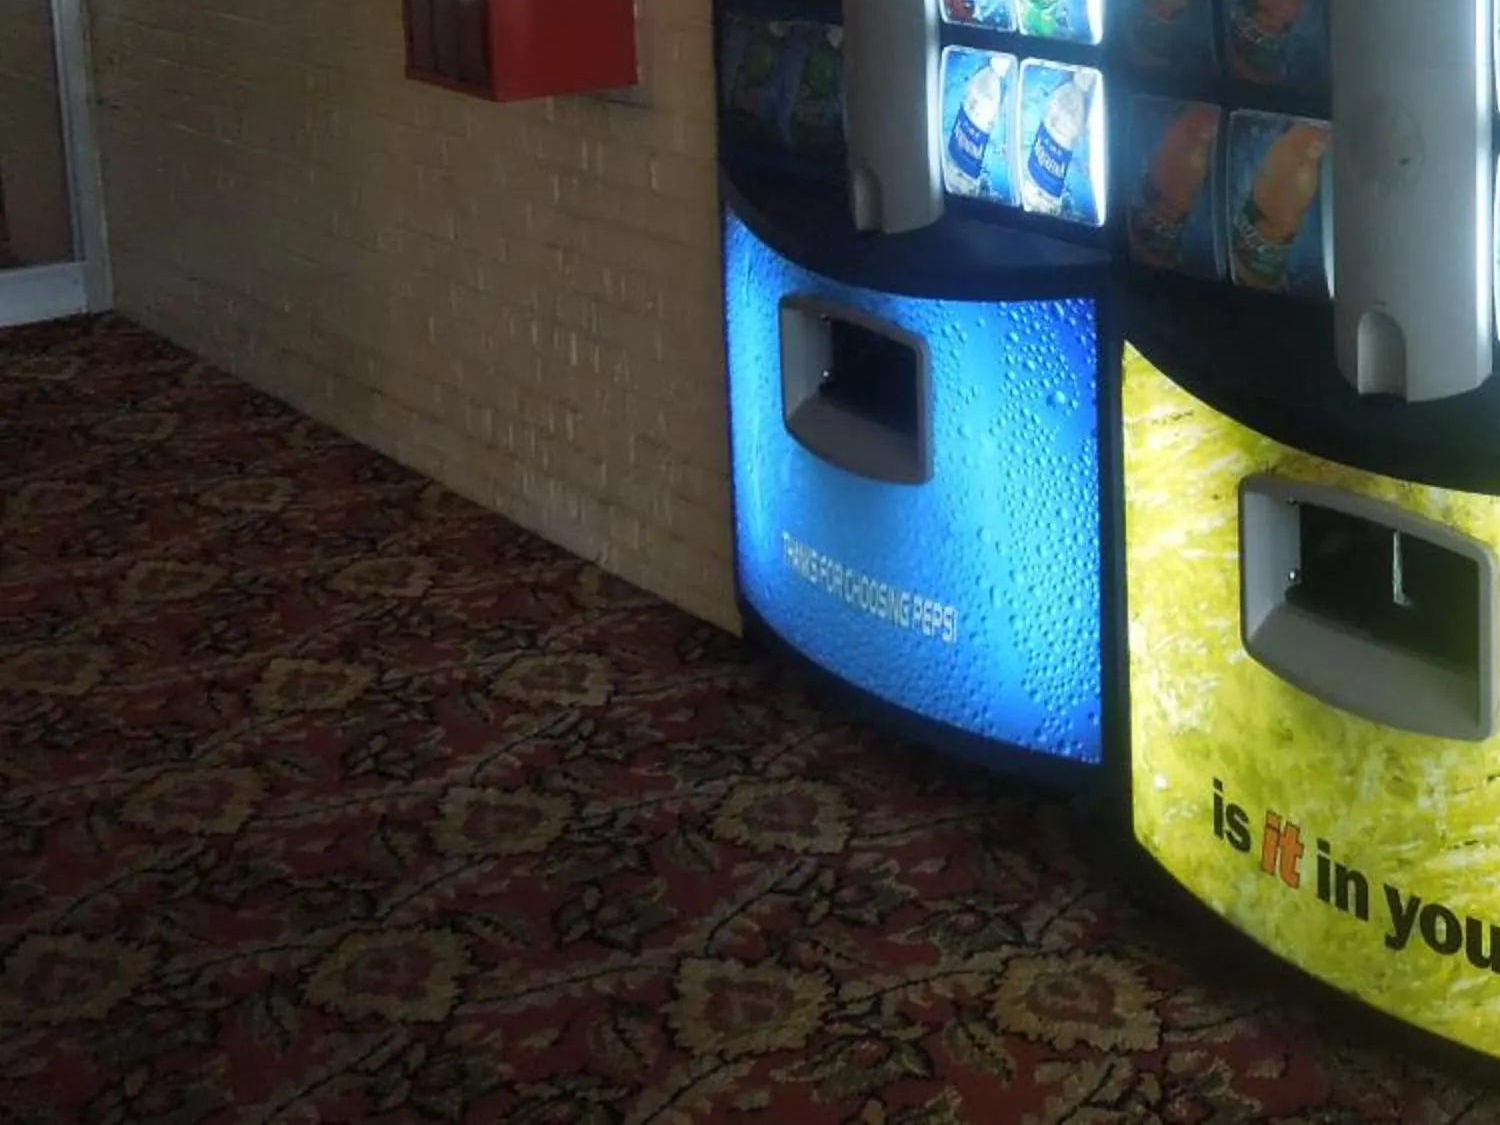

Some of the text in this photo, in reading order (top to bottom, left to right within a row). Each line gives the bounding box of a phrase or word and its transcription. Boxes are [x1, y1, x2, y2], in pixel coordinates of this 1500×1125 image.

[912, 591, 960, 644] PEPSI
[1213, 777, 1252, 854] is
[1260, 810, 1306, 890] it
[1316, 837, 1370, 922] in
